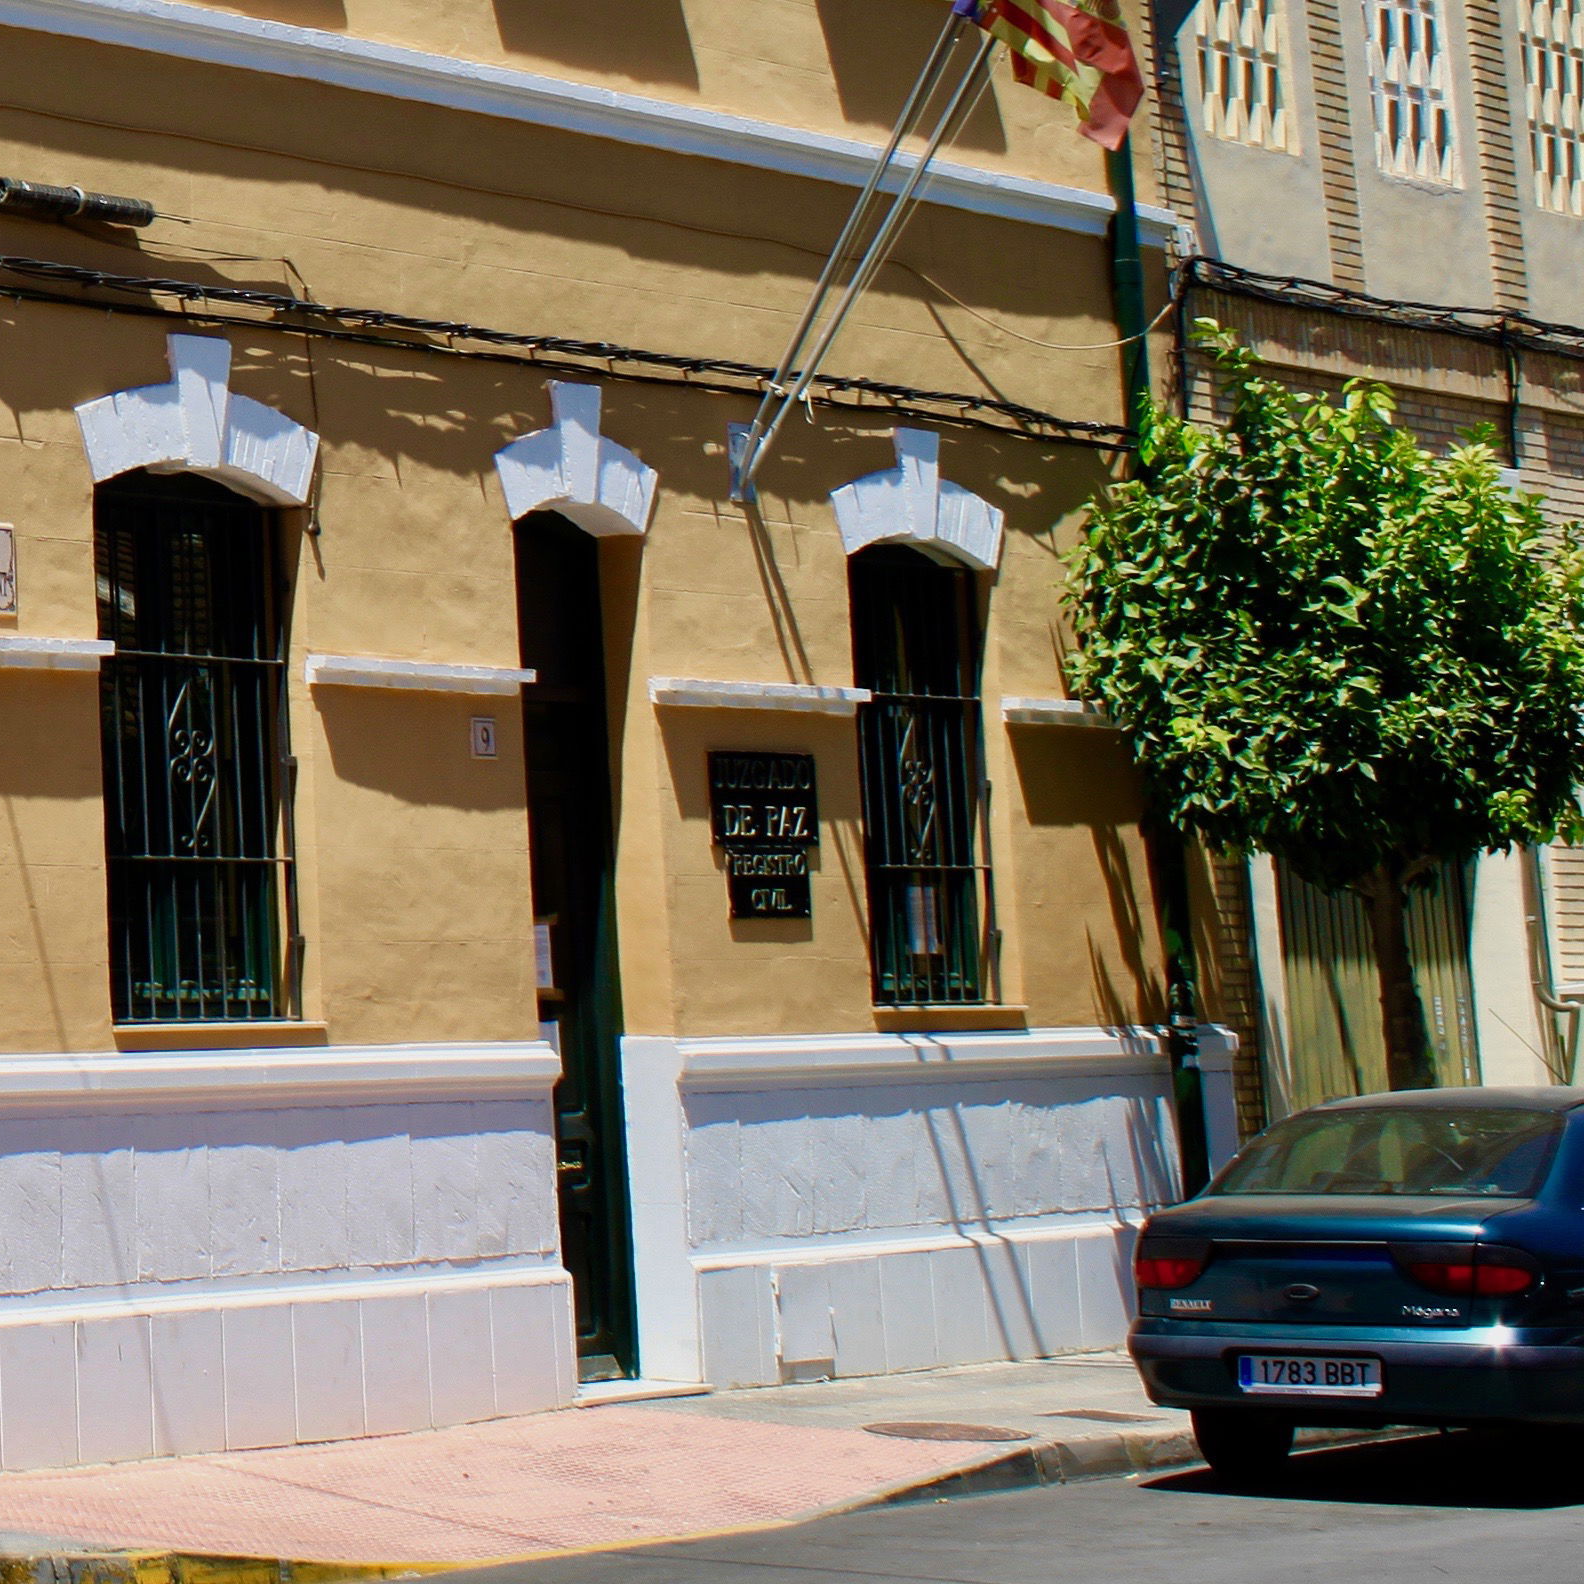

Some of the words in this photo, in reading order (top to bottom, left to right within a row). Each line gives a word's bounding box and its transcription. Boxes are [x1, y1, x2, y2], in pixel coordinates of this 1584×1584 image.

[481, 726, 490, 752] 9
[713, 758, 811, 789] JUZGADO
[722, 804, 756, 836] DE
[764, 805, 808, 837] PAZ
[732, 853, 807, 876] REGISTRO
[751, 888, 793, 910] CIVIL
[1260, 1359, 1317, 1385] 1783
[1324, 1361, 1371, 1387] BBT
